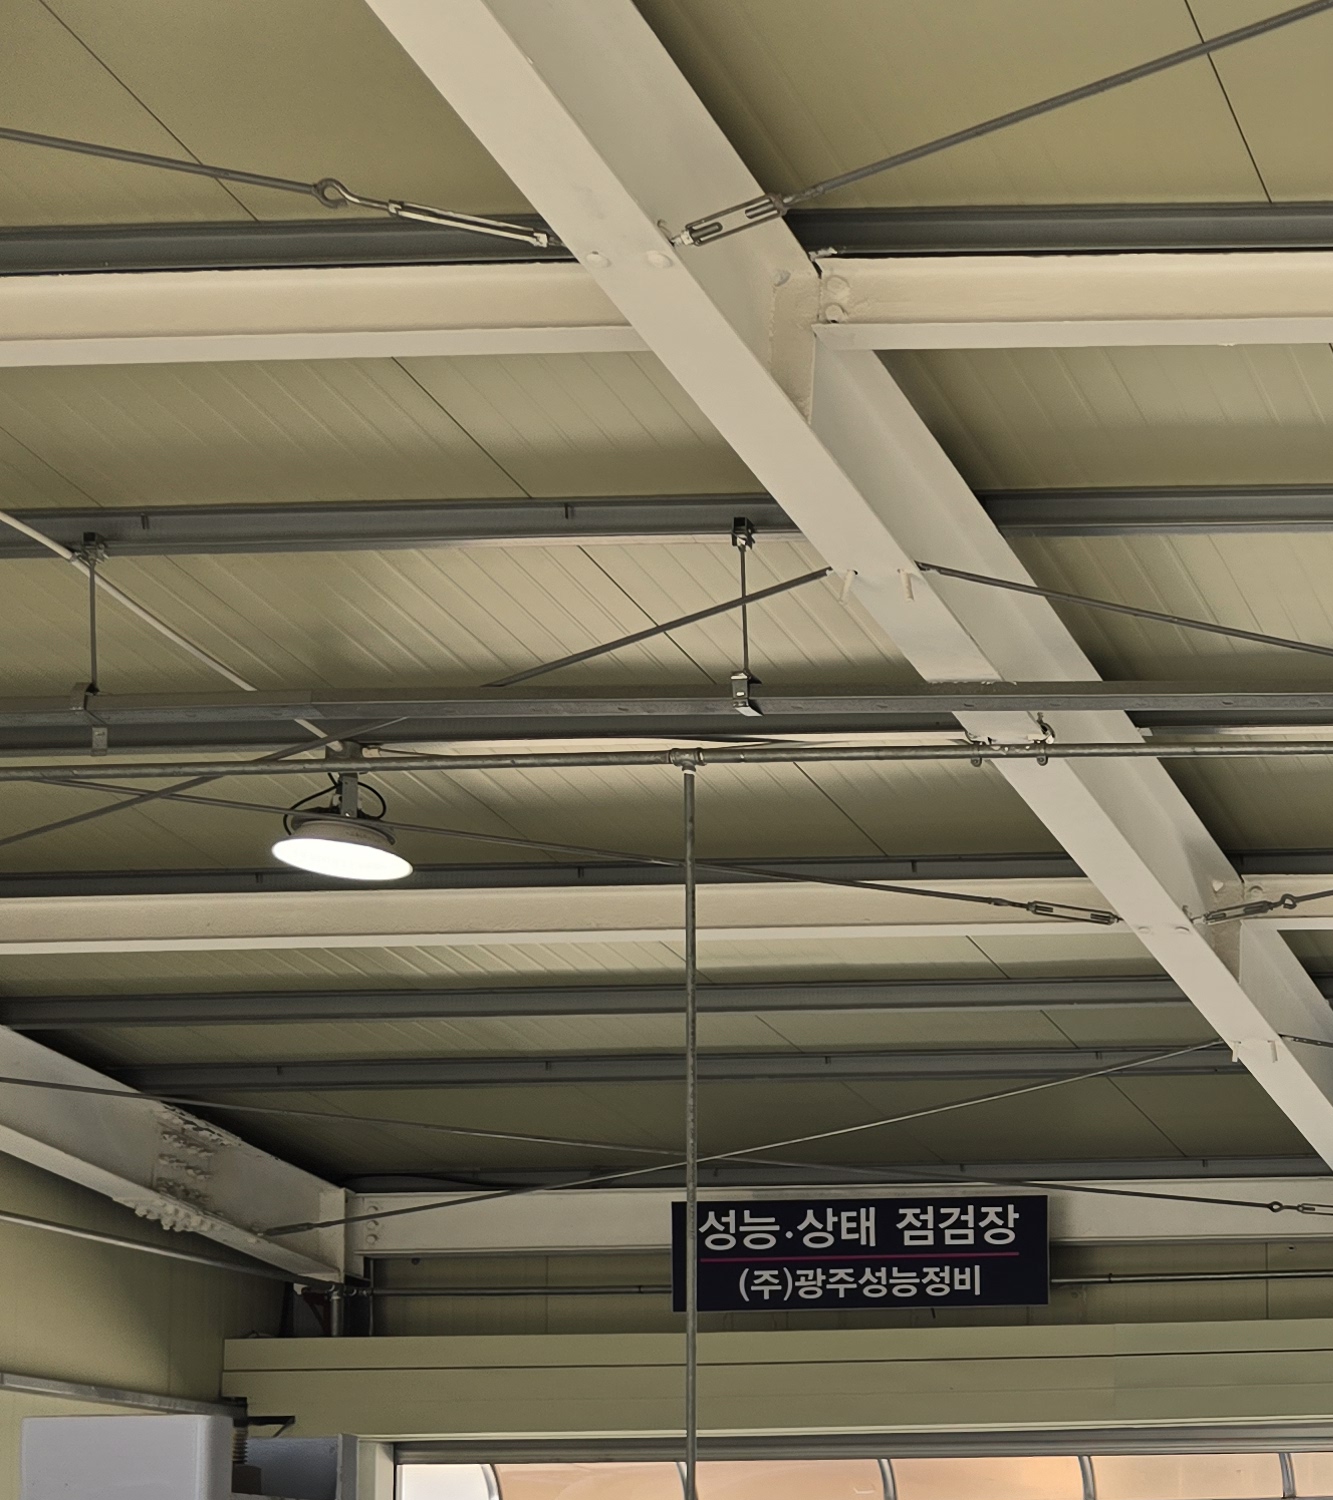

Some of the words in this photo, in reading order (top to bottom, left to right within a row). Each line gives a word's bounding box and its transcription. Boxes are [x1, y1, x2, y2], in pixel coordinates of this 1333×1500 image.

[699, 1207, 876, 1250] 성능·상태
[896, 1204, 1019, 1246] 점검장
[739, 1265, 982, 1302] (주)광주성능정비
